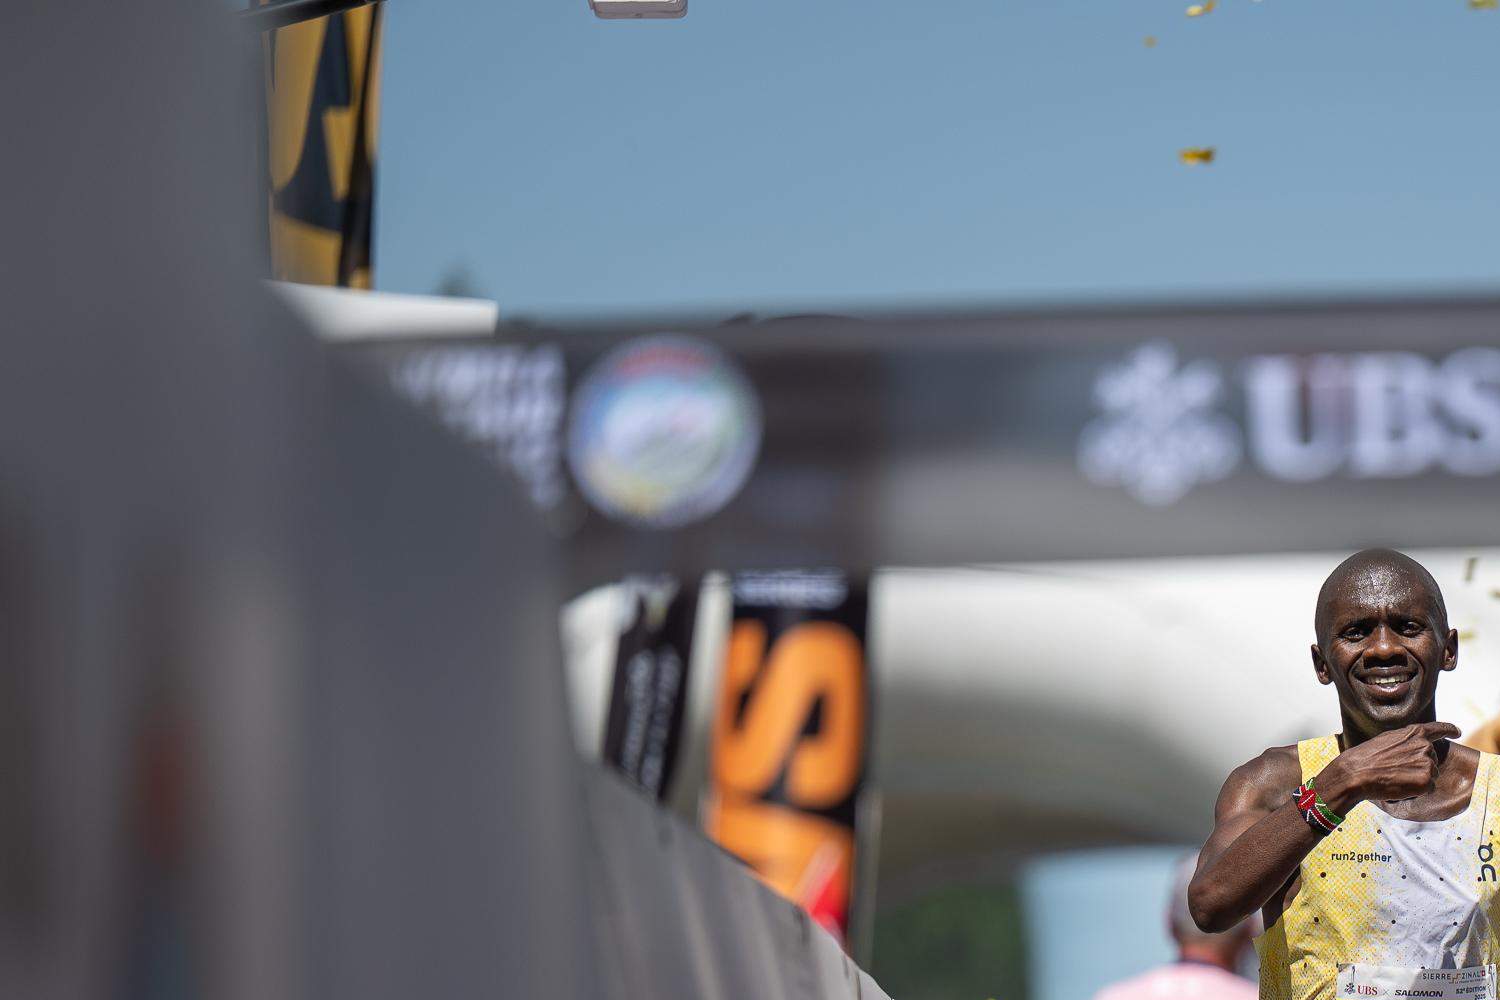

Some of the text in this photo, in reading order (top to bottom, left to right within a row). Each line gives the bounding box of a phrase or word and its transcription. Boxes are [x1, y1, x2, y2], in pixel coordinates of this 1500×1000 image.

[1461, 971, 1480, 979] ZINAL
[1357, 984, 1444, 998] UBS SALOMON
